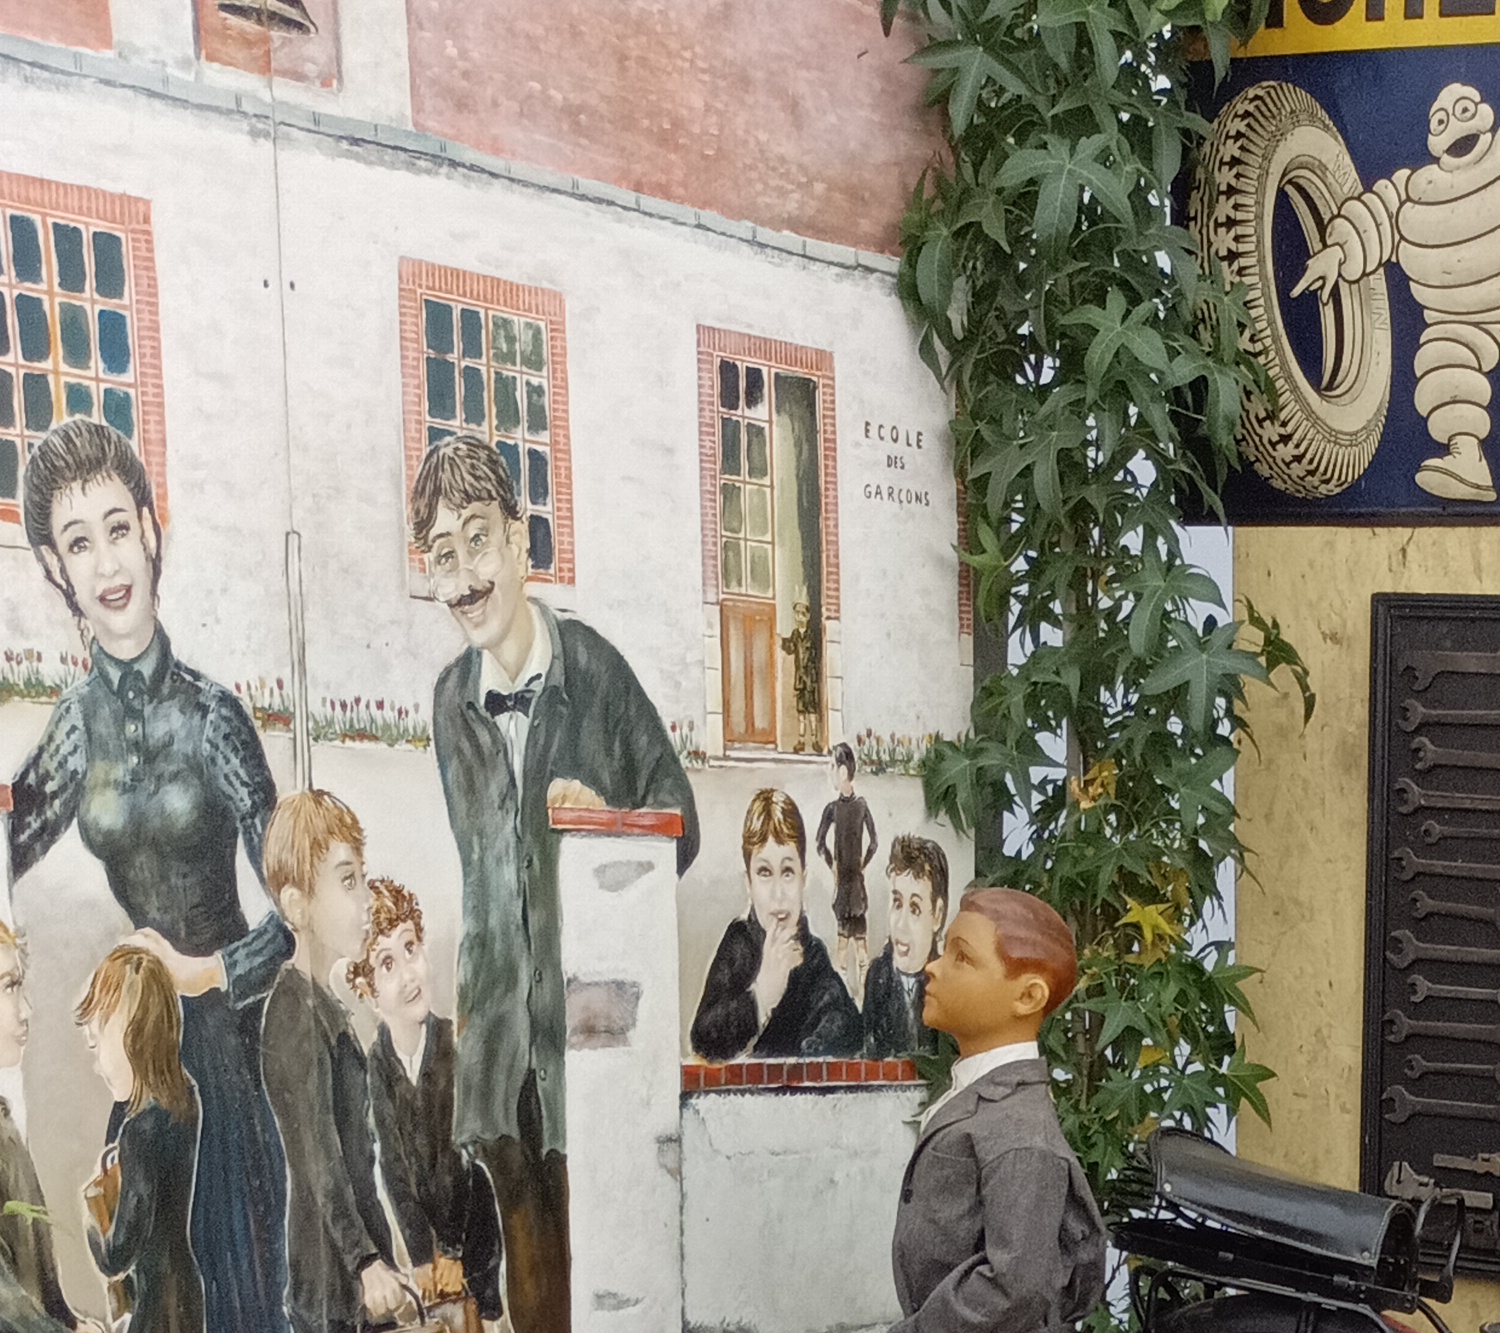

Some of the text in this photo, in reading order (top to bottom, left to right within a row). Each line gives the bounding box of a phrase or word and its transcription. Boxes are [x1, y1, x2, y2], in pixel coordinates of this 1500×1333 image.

[863, 420, 925, 450] ECOLE
[886, 454, 905, 471] DES
[863, 482, 931, 509] GARÇONS
